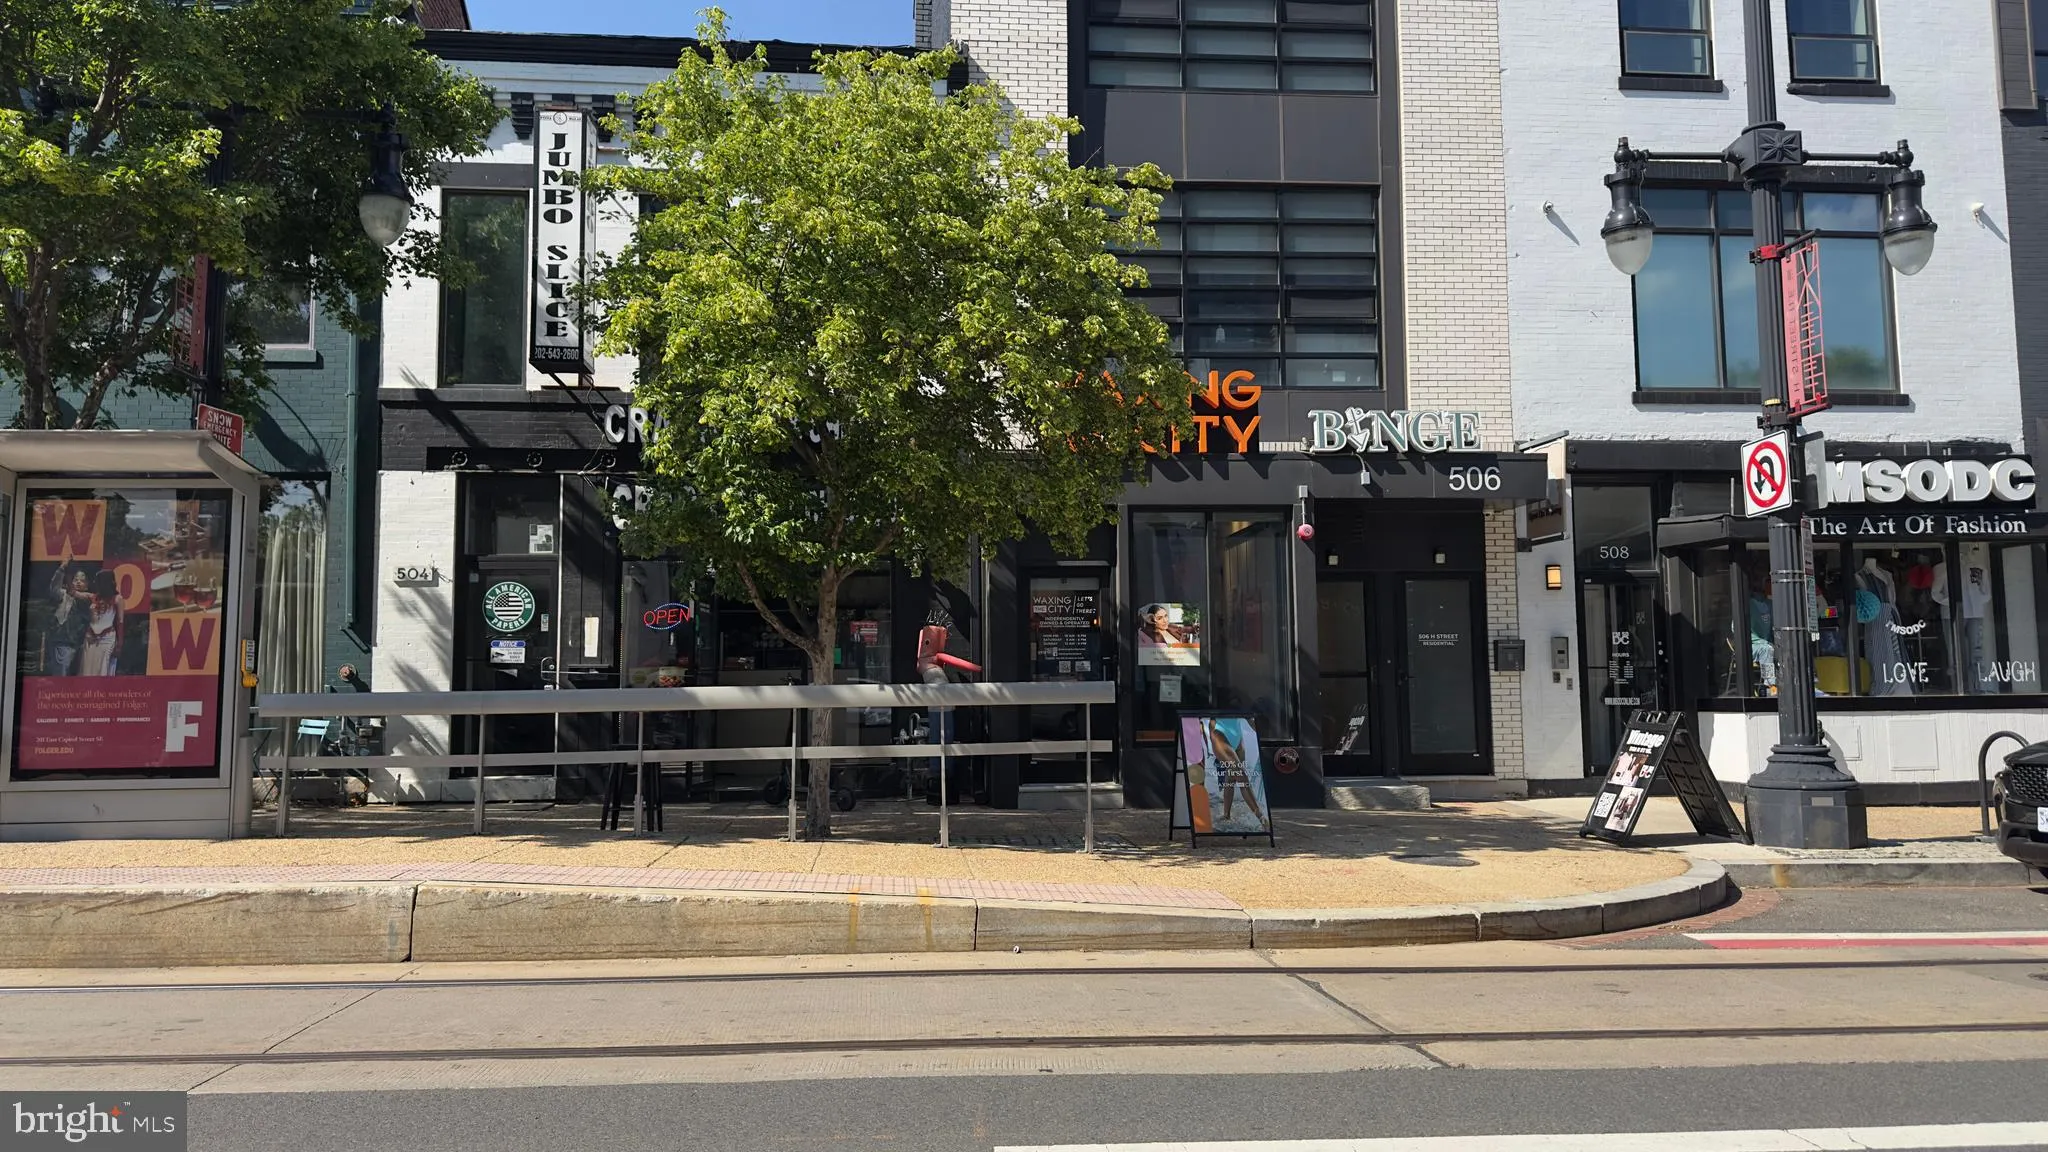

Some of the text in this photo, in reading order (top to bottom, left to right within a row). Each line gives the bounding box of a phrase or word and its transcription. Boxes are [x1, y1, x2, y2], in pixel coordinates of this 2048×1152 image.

[542, 132, 576, 224] JUMBO
[544, 244, 569, 338] SLICE
[534, 347, 580, 360] 202-543-2600
[207, 410, 233, 428] SNOW
[1448, 466, 1502, 492] 506
[1806, 514, 2028, 535] The Art Of Fashion
[1599, 545, 1630, 559] 508
[396, 567, 430, 580] 504
[484, 584, 533, 610] ALL AMERICAN
[1032, 596, 1072, 605] WAXING
[643, 606, 691, 627] OPEN
[1047, 605, 1073, 614] CITY
[491, 616, 526, 629] PAPERS
[1883, 661, 1929, 684] LOVE
[1977, 660, 2036, 683] LAUGH
[1227, 769, 1244, 777] first
